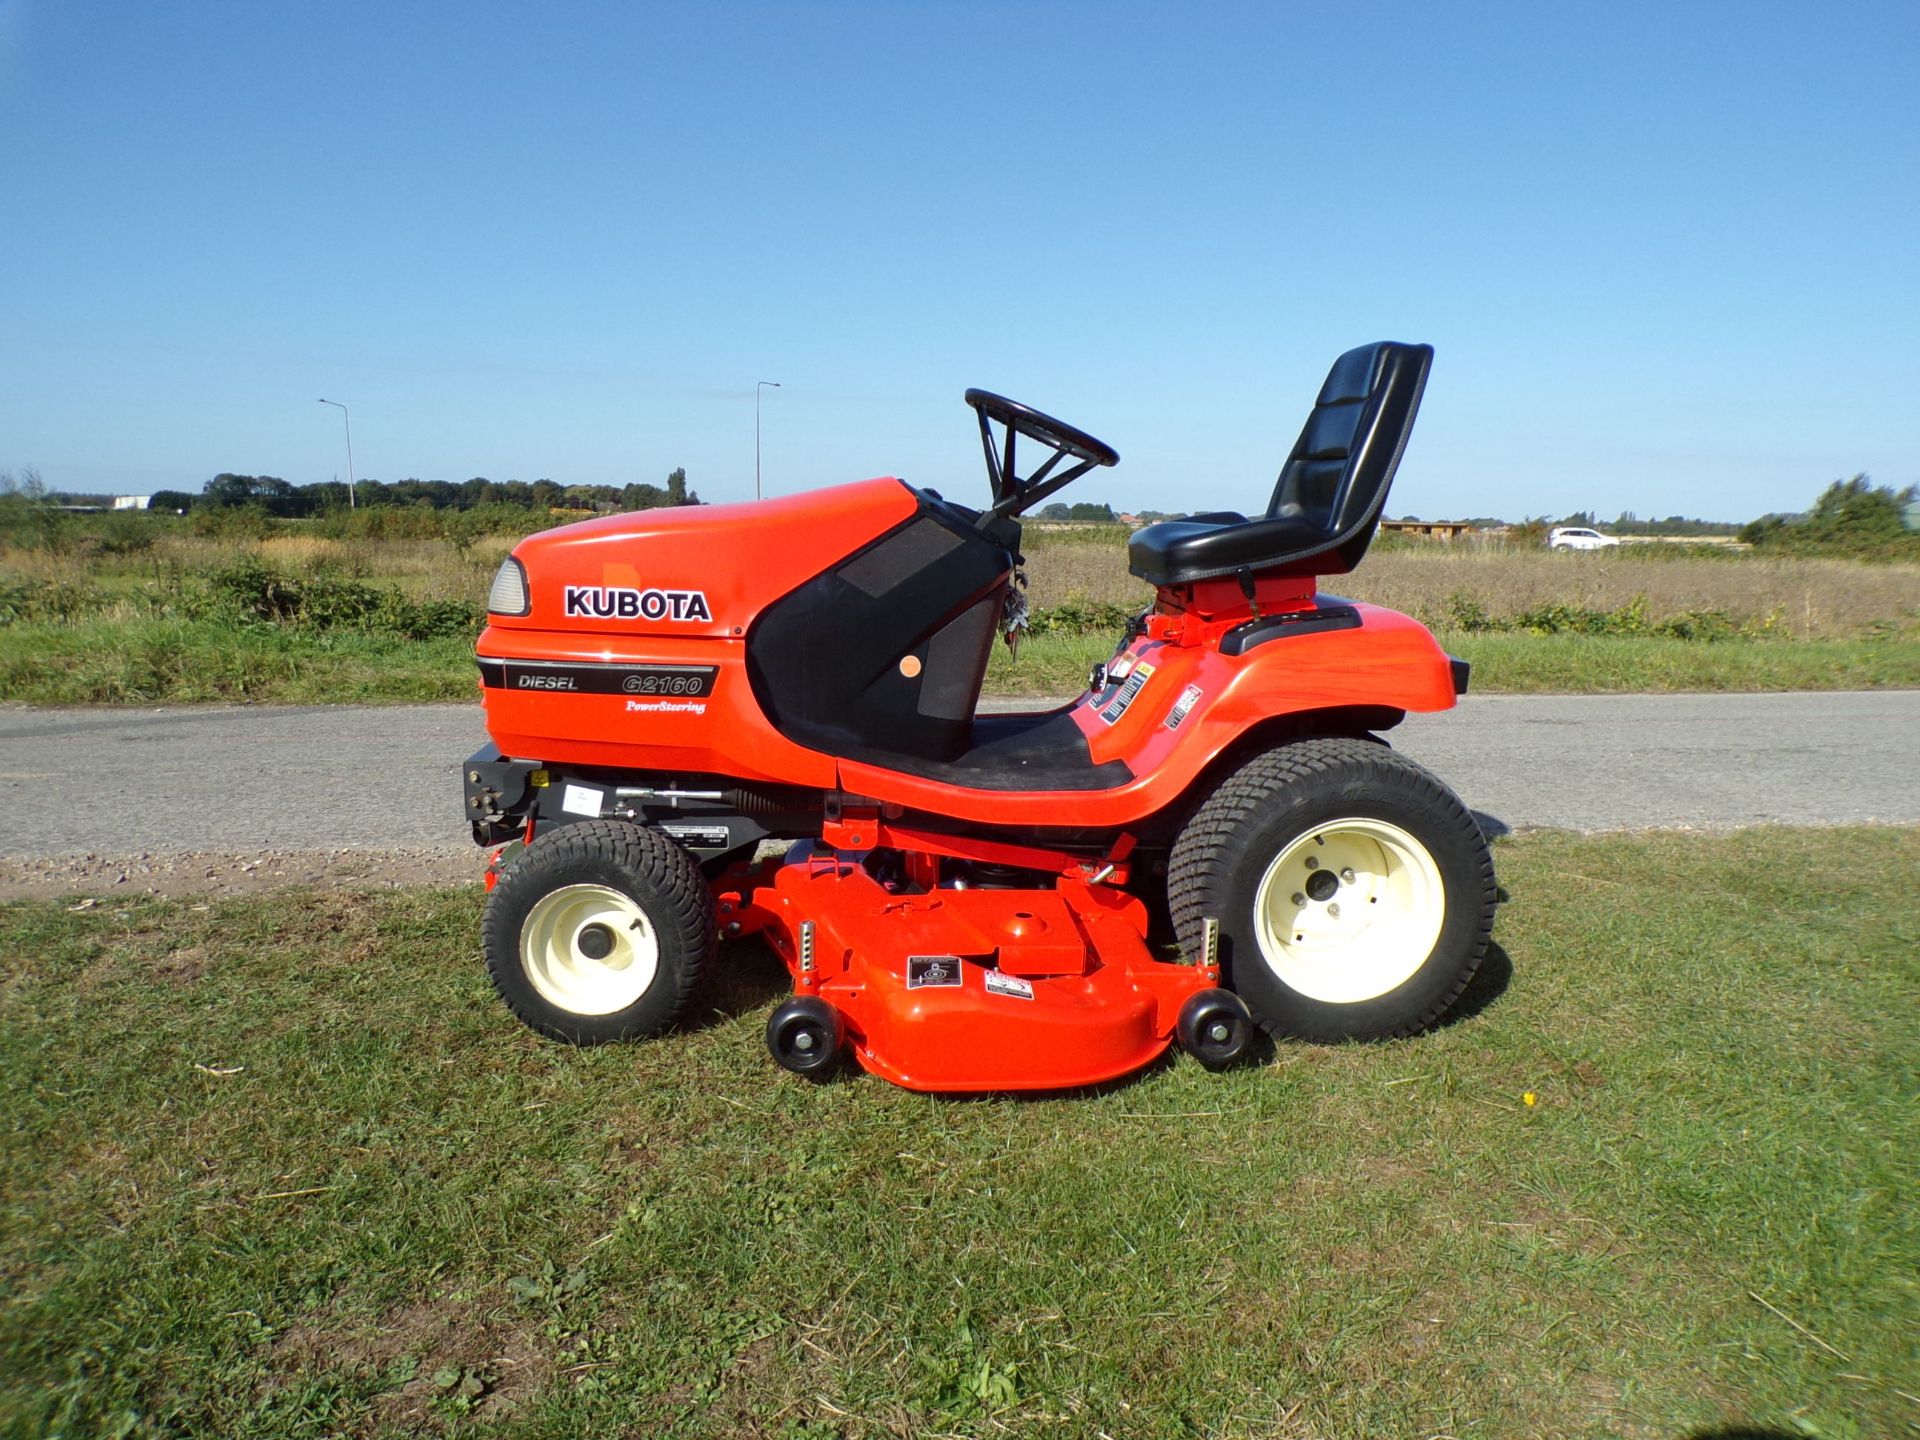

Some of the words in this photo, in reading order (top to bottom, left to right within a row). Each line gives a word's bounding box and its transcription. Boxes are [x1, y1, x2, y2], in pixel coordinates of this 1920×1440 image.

[566, 587, 711, 621] KUBOTA
[518, 674, 578, 690] DIESEL
[622, 675, 703, 694] G2160
[626, 700, 706, 714] PowerSteering
